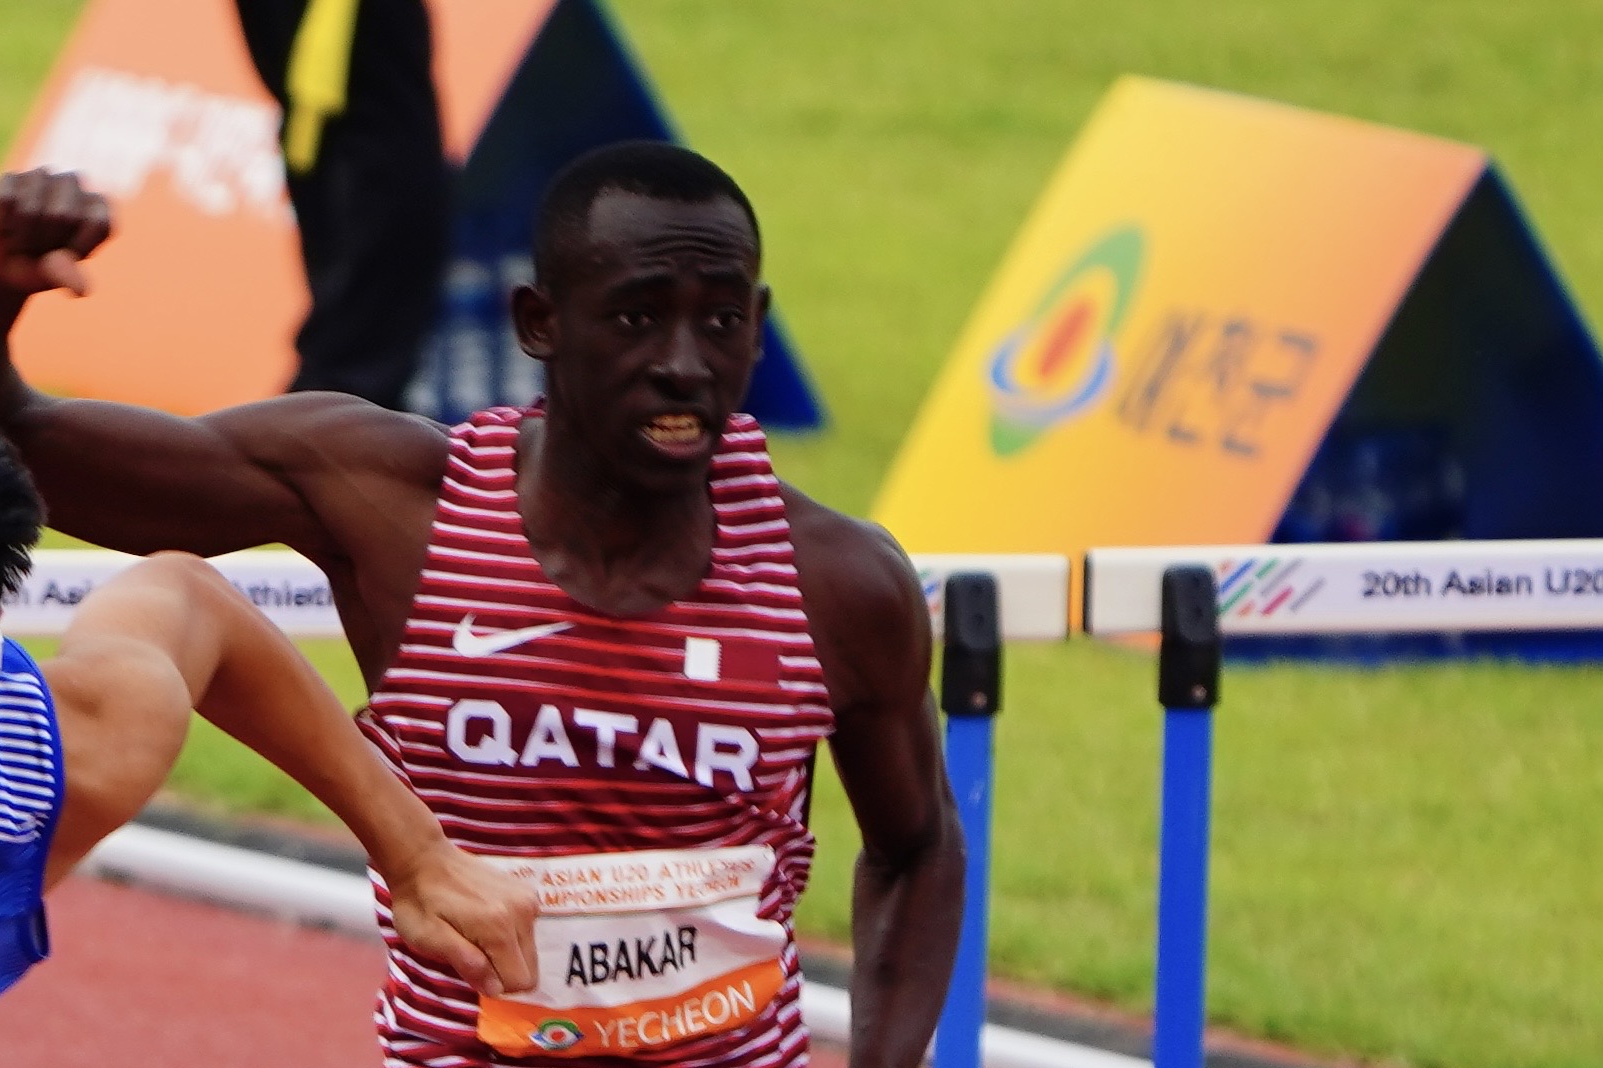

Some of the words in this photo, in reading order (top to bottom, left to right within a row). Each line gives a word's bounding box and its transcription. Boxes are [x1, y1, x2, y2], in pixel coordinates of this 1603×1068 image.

[1361, 569, 1433, 599] 20th
[1439, 568, 1534, 597] Asian
[446, 699, 760, 792] QATAR
[566, 926, 698, 987] ABAKAR
[595, 980, 756, 1049] YECHEON
